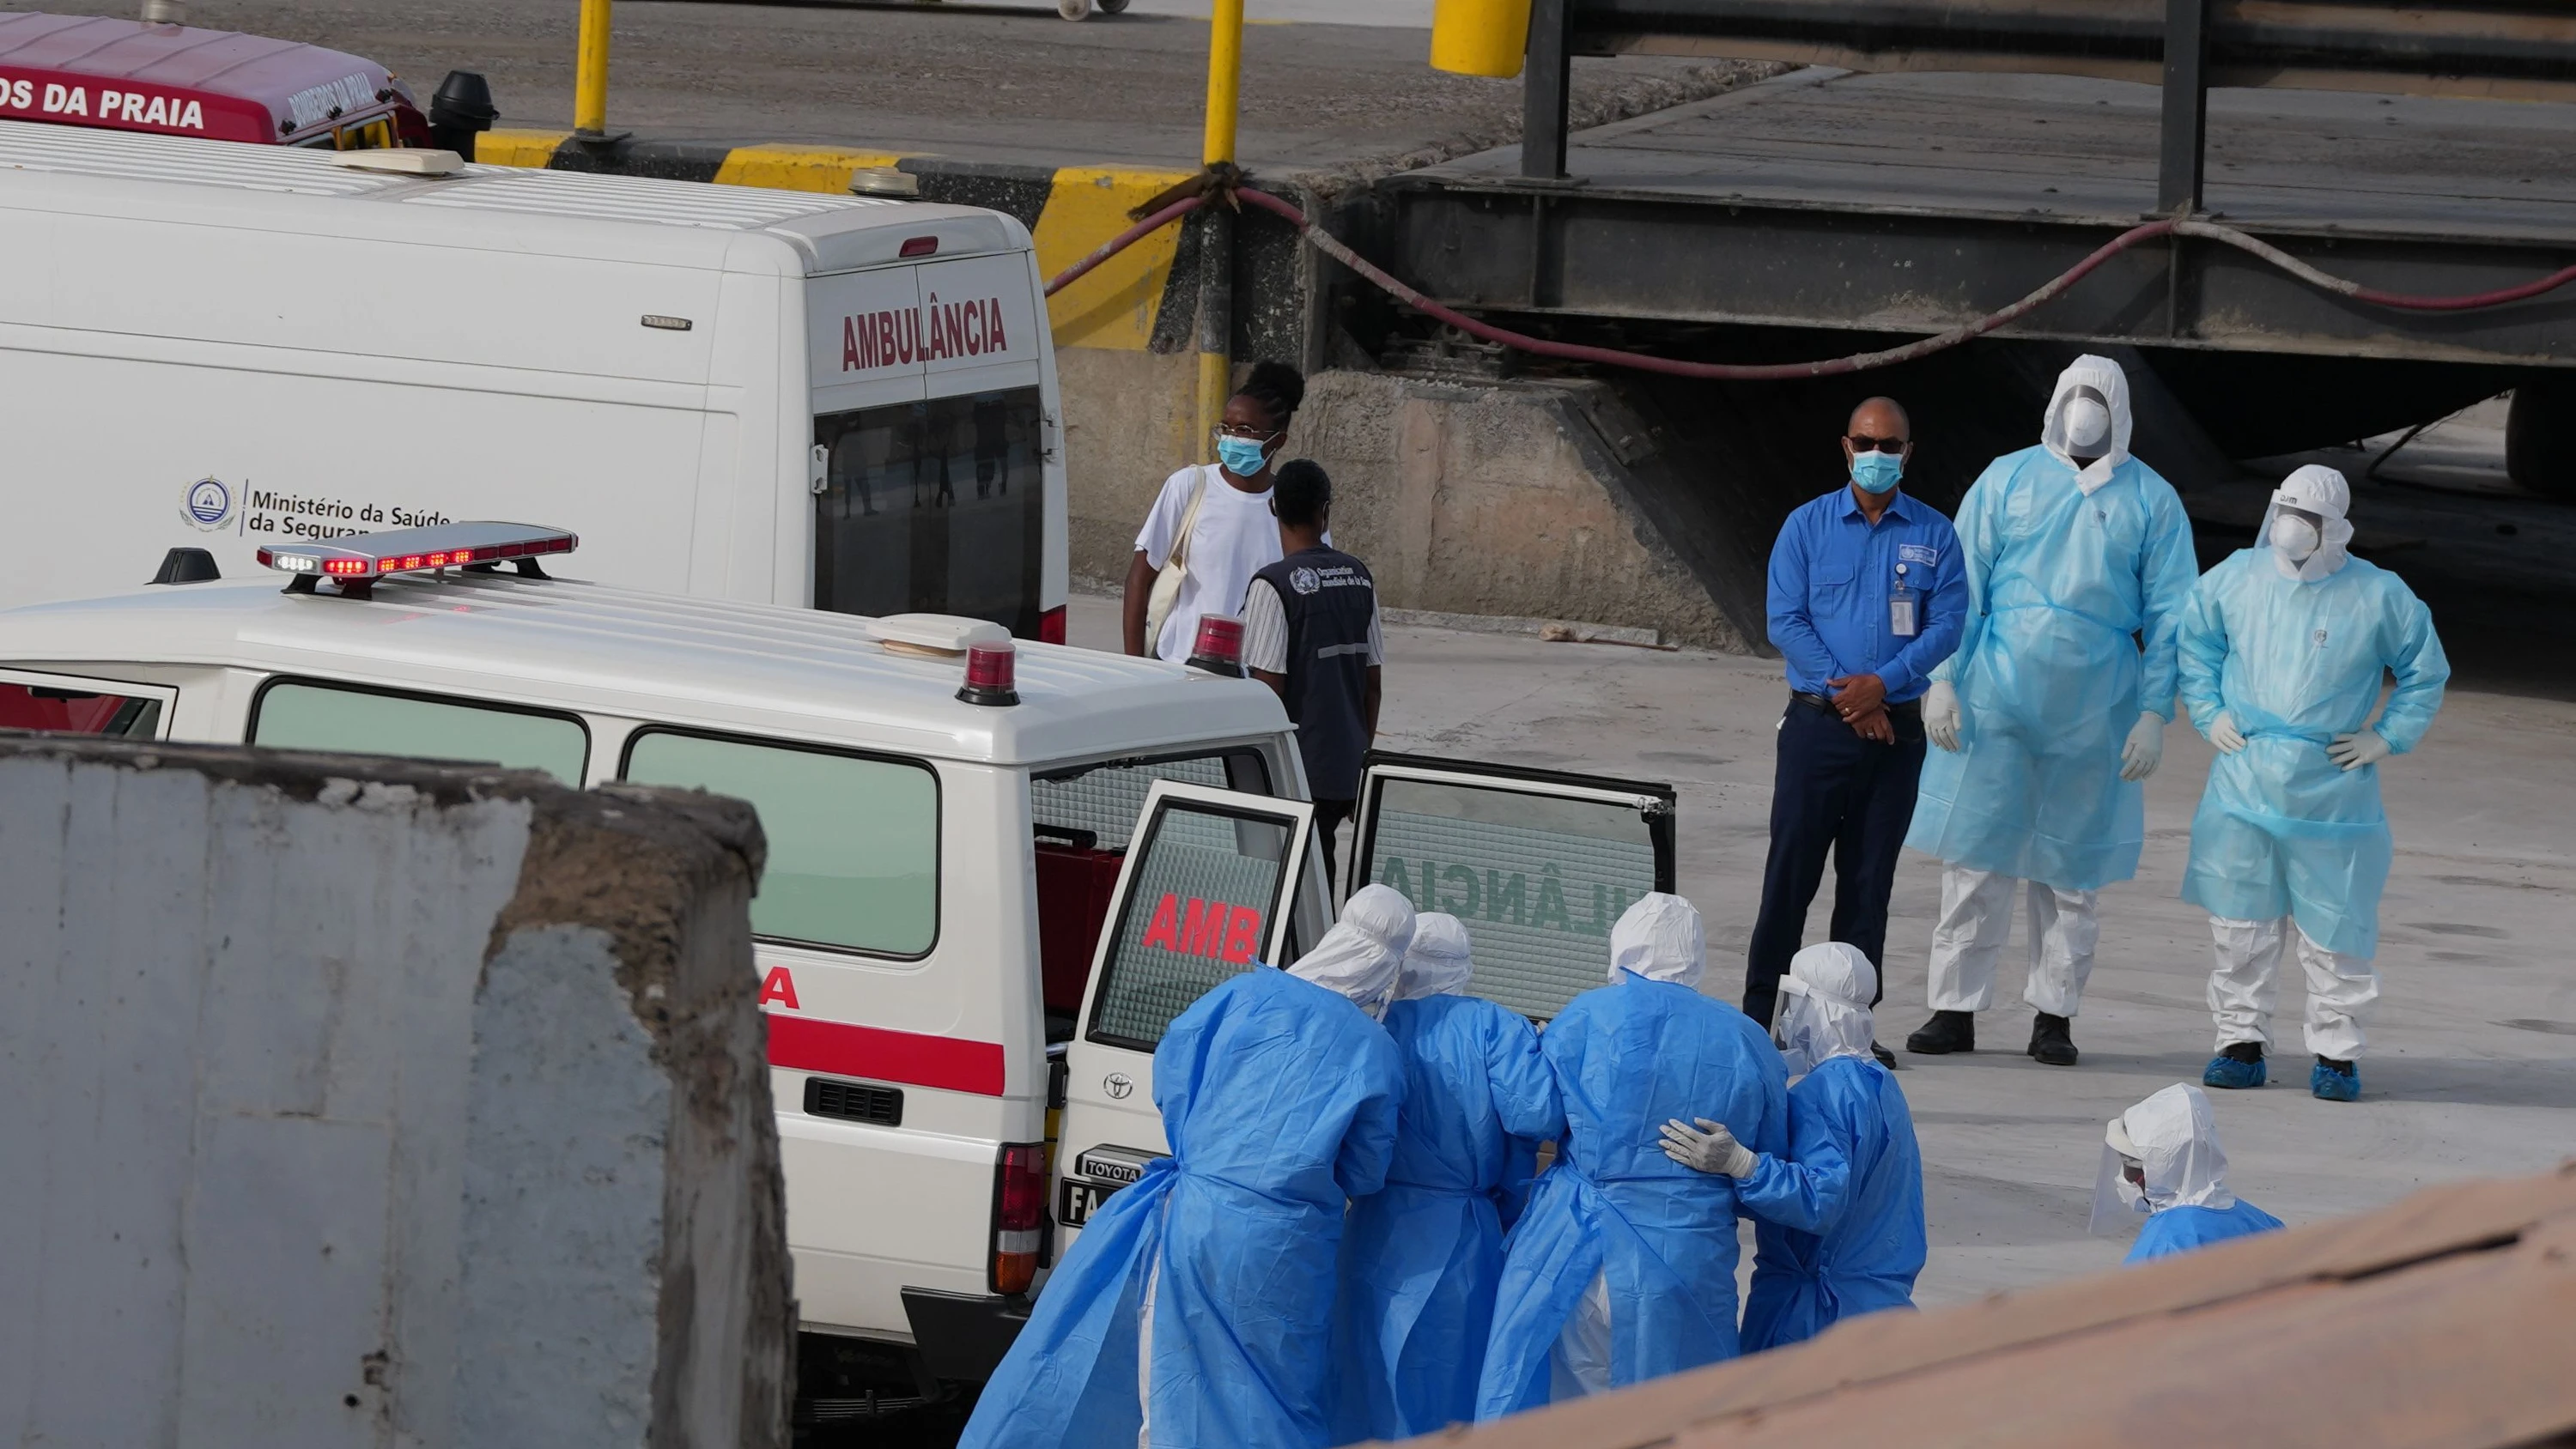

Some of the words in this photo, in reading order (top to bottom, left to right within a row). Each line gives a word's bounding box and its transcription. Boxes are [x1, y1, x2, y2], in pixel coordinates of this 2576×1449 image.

[43, 83, 88, 117] DA
[99, 90, 204, 129] PRAIA
[842, 292, 1007, 372] AMBULÂNCIA
[249, 512, 274, 532] da
[252, 490, 354, 519] Ministério
[360, 503, 383, 523] da
[392, 506, 450, 528] Saúde
[1347, 576, 1355, 585] de
[1142, 892, 1261, 965] AMB
[758, 966, 800, 1009] A
[1088, 1161, 1138, 1182] TOYOTA
